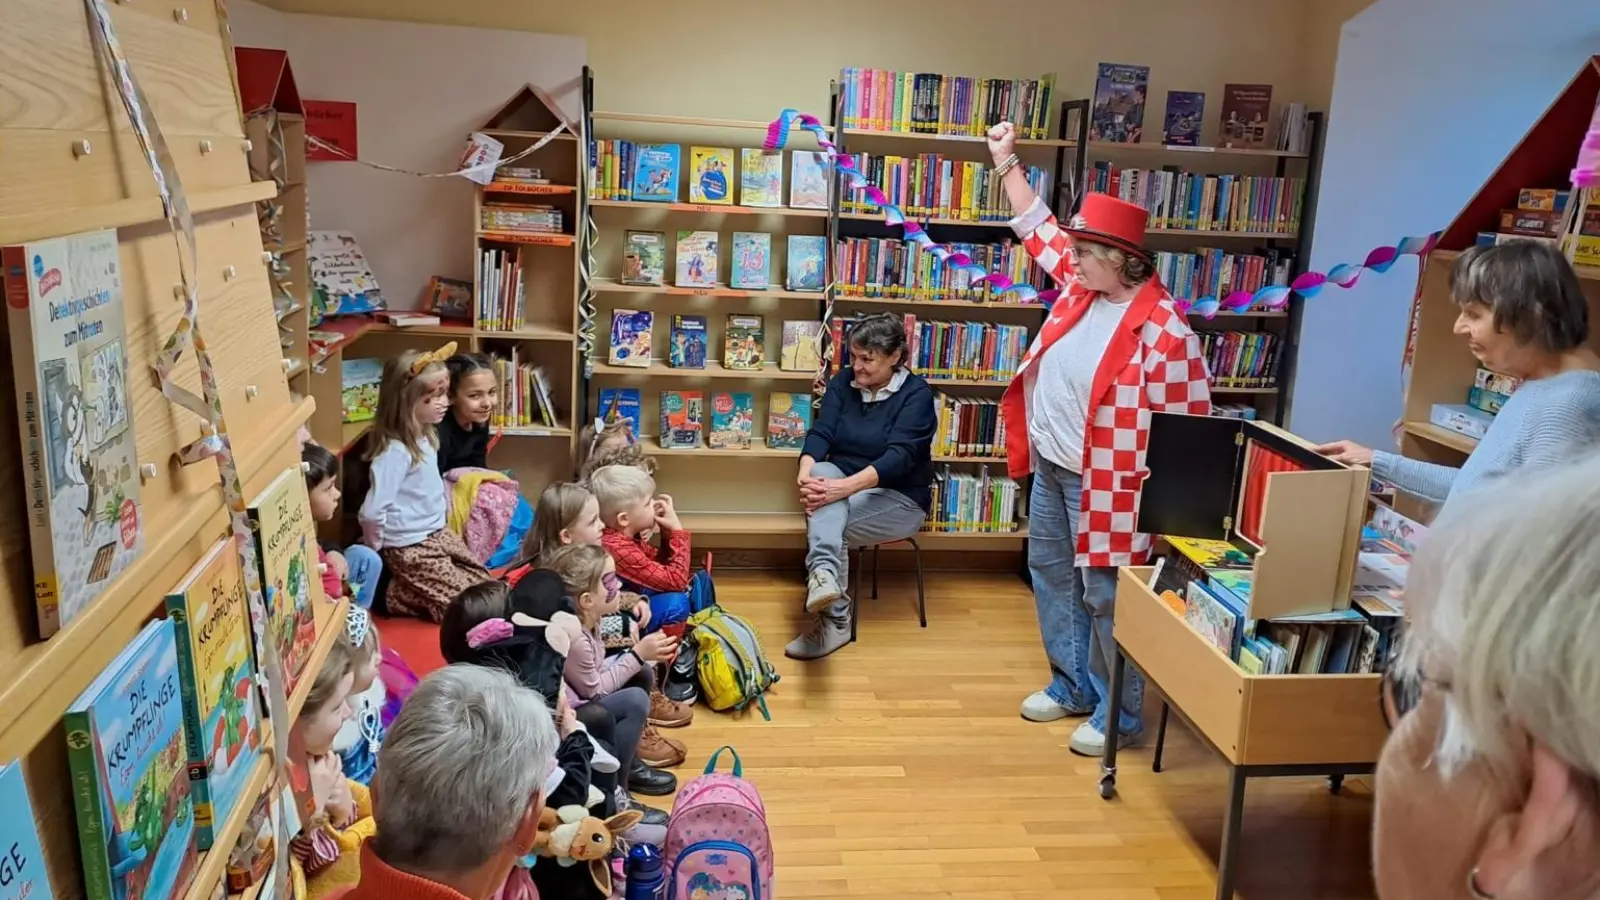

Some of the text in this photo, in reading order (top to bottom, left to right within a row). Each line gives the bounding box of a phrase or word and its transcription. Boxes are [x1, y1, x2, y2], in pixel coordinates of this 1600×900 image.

[64, 320, 104, 348] zum Mitraten
[211, 579, 224, 605] DIE
[198, 579, 244, 650] KRUMPFLINGE
[129, 679, 148, 715] DIE
[107, 674, 176, 778] KRUMPFLINGE
